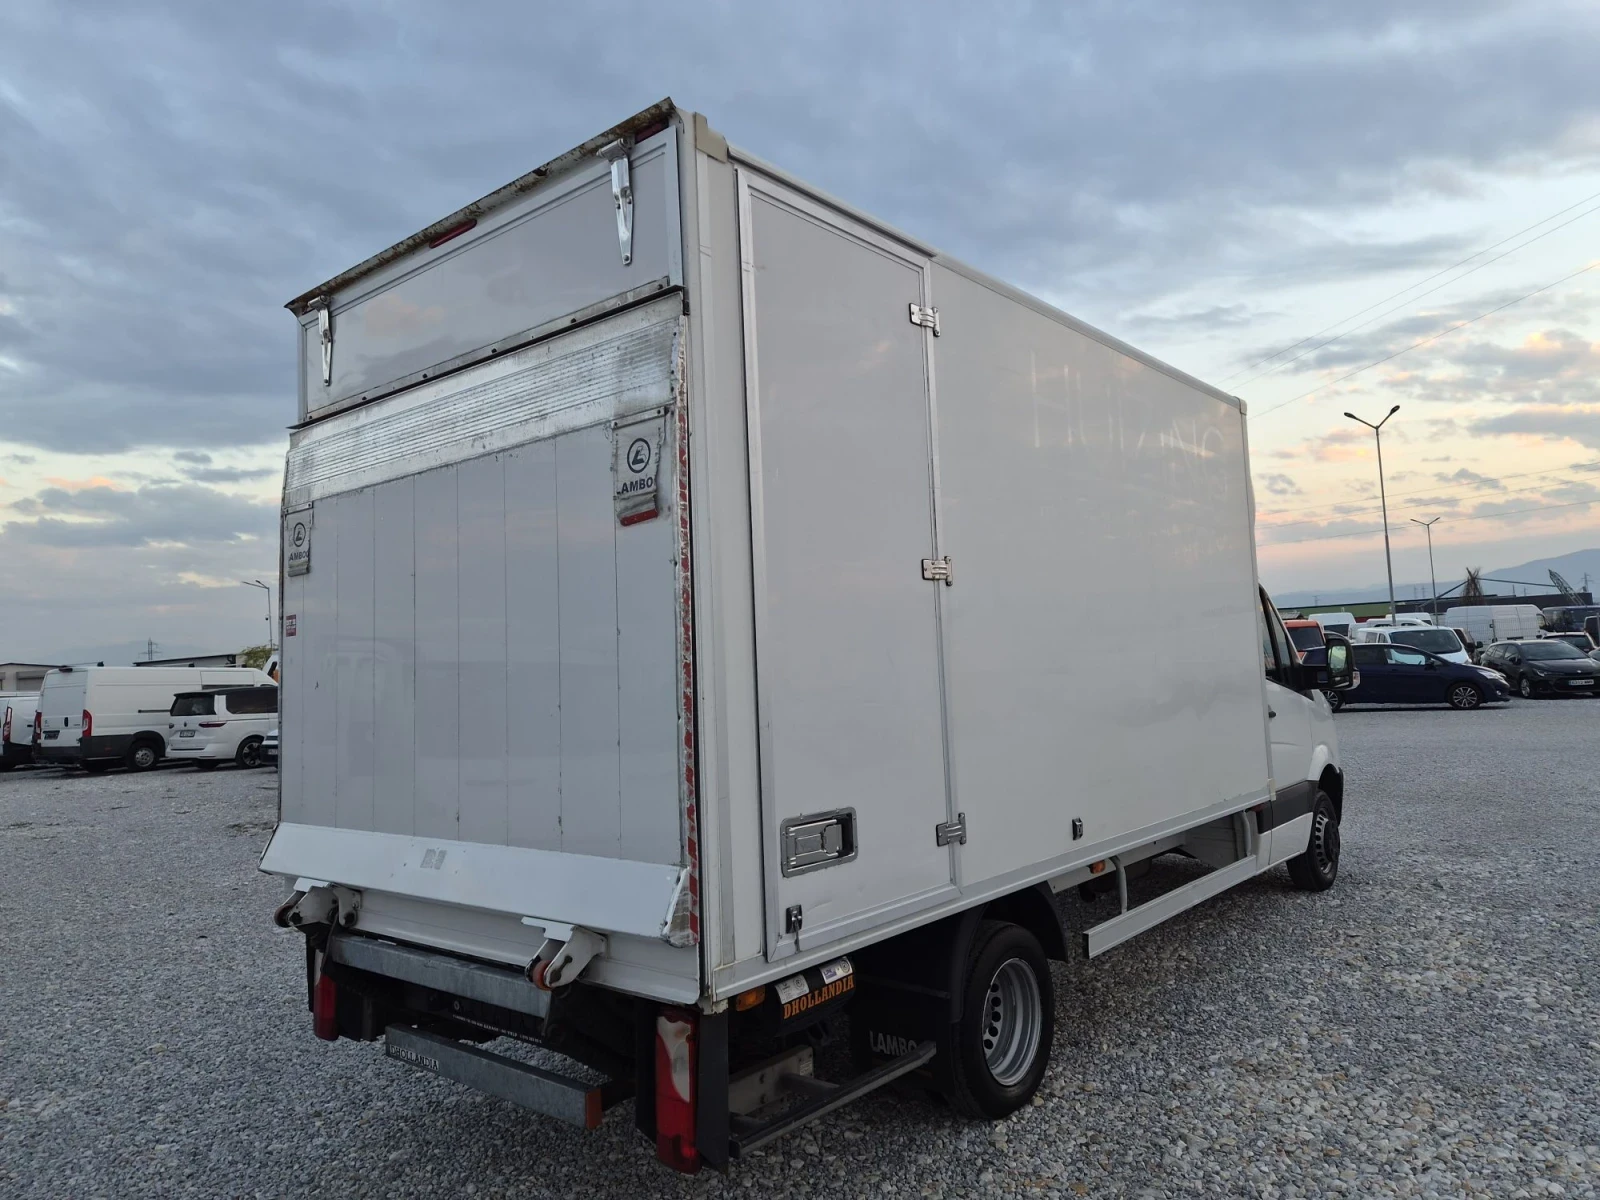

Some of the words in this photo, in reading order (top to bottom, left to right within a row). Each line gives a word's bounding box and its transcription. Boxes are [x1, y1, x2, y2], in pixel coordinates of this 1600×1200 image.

[616, 477, 654, 495] AMBO
[783, 975, 855, 1019] DHOLLANDIA
[390, 1045, 438, 1070] DHOLLANDIA
